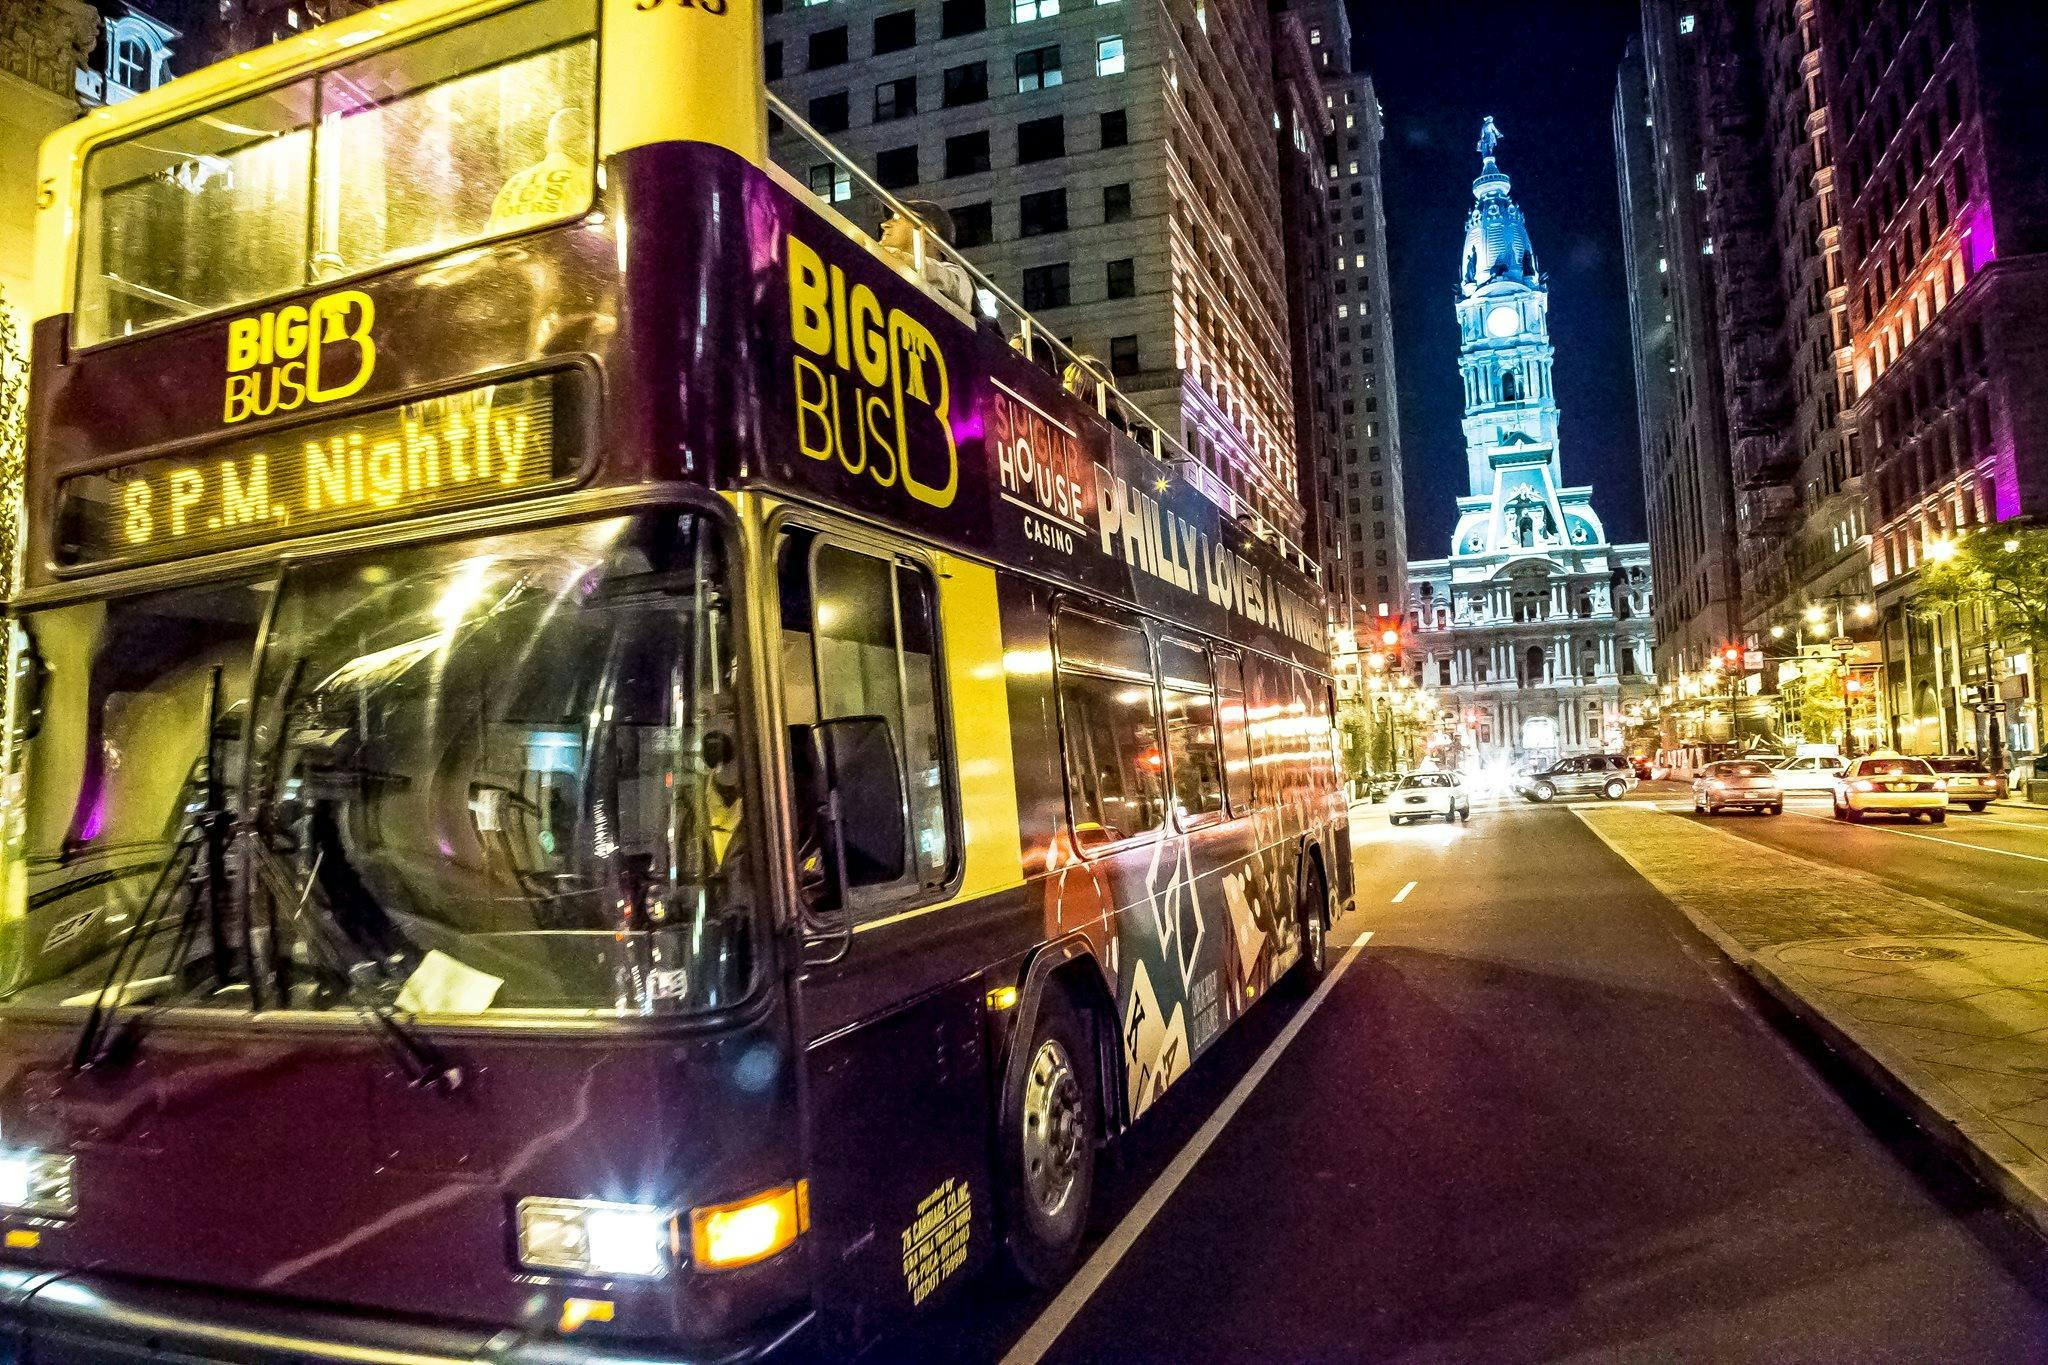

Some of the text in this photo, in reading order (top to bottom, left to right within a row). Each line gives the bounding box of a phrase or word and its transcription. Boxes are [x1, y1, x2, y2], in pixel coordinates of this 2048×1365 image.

[227, 305, 308, 373] BIG
[787, 233, 888, 387] BIG
[223, 361, 306, 423] BUS
[793, 354, 898, 487] BUS
[124, 479, 153, 544] 8
[305, 406, 530, 509] Nightly
[995, 393, 1079, 481] SUGAR
[997, 437, 1085, 525] HOUSE
[1023, 515, 1074, 556] CASINO
[1093, 461, 1199, 596] PHILLY
[1202, 532, 1266, 627] LOVES
[1266, 574, 1281, 632] A
